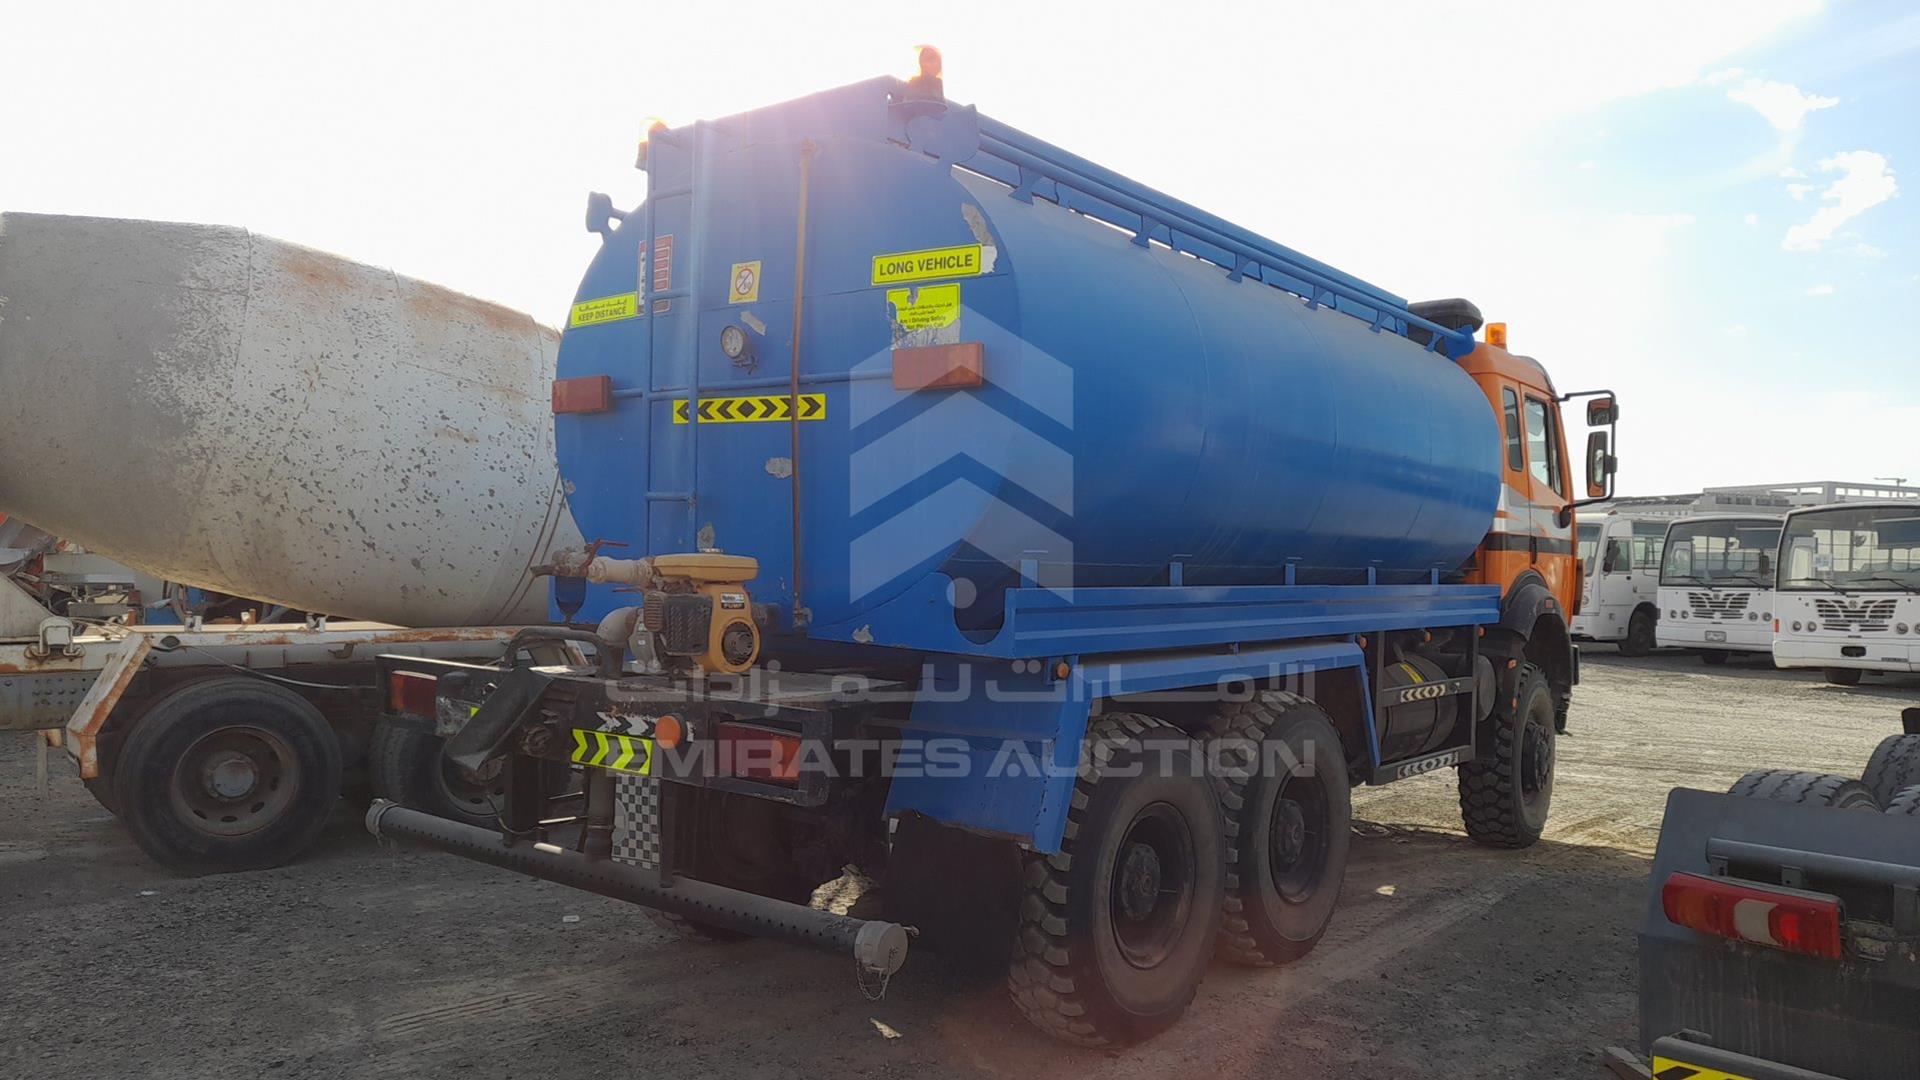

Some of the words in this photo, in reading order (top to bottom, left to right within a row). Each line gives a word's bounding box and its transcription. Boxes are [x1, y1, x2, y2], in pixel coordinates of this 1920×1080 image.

[879, 260, 914, 276] LONG
[917, 253, 974, 272] VEHICLE
[578, 310, 594, 320] KEEP
[595, 305, 627, 320] DISTANCE
